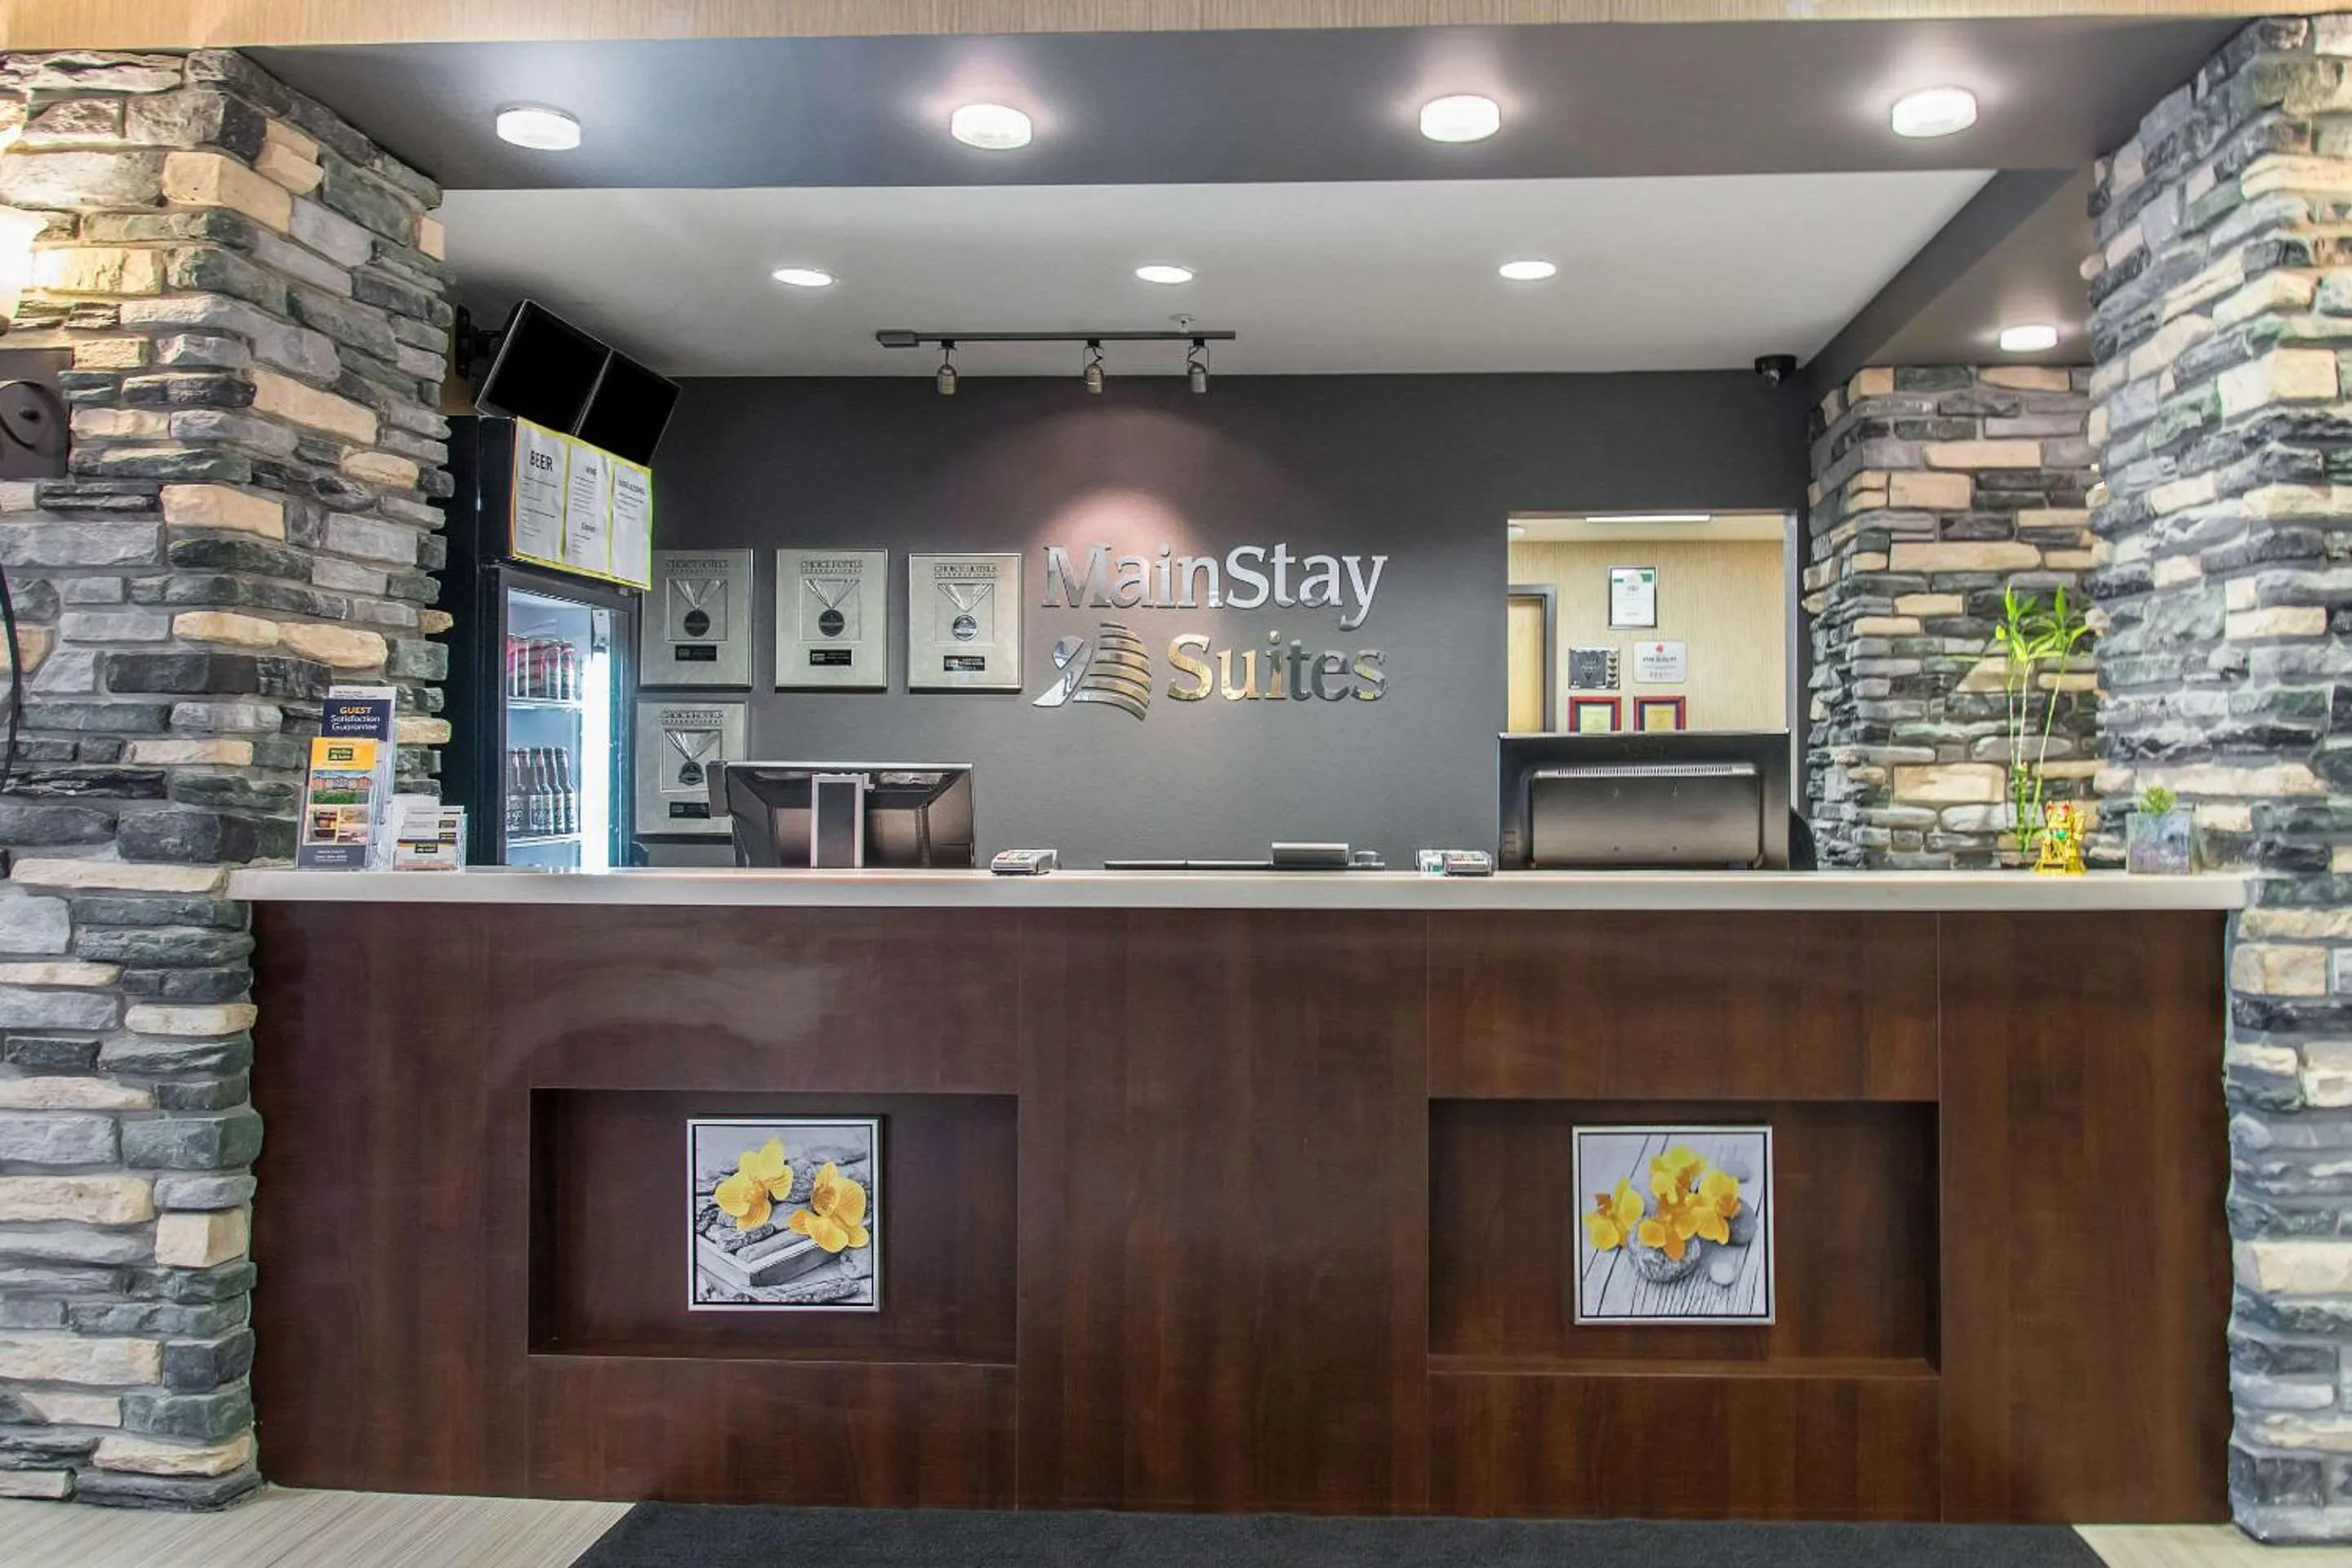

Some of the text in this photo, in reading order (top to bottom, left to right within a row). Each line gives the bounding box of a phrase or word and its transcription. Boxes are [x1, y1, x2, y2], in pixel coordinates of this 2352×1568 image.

[530, 450, 553, 471] BEER
[1041, 542, 1388, 630] MainStay
[1167, 630, 1388, 702] Suites
[330, 715, 381, 723] Satisfaction
[340, 706, 372, 715] GUEST
